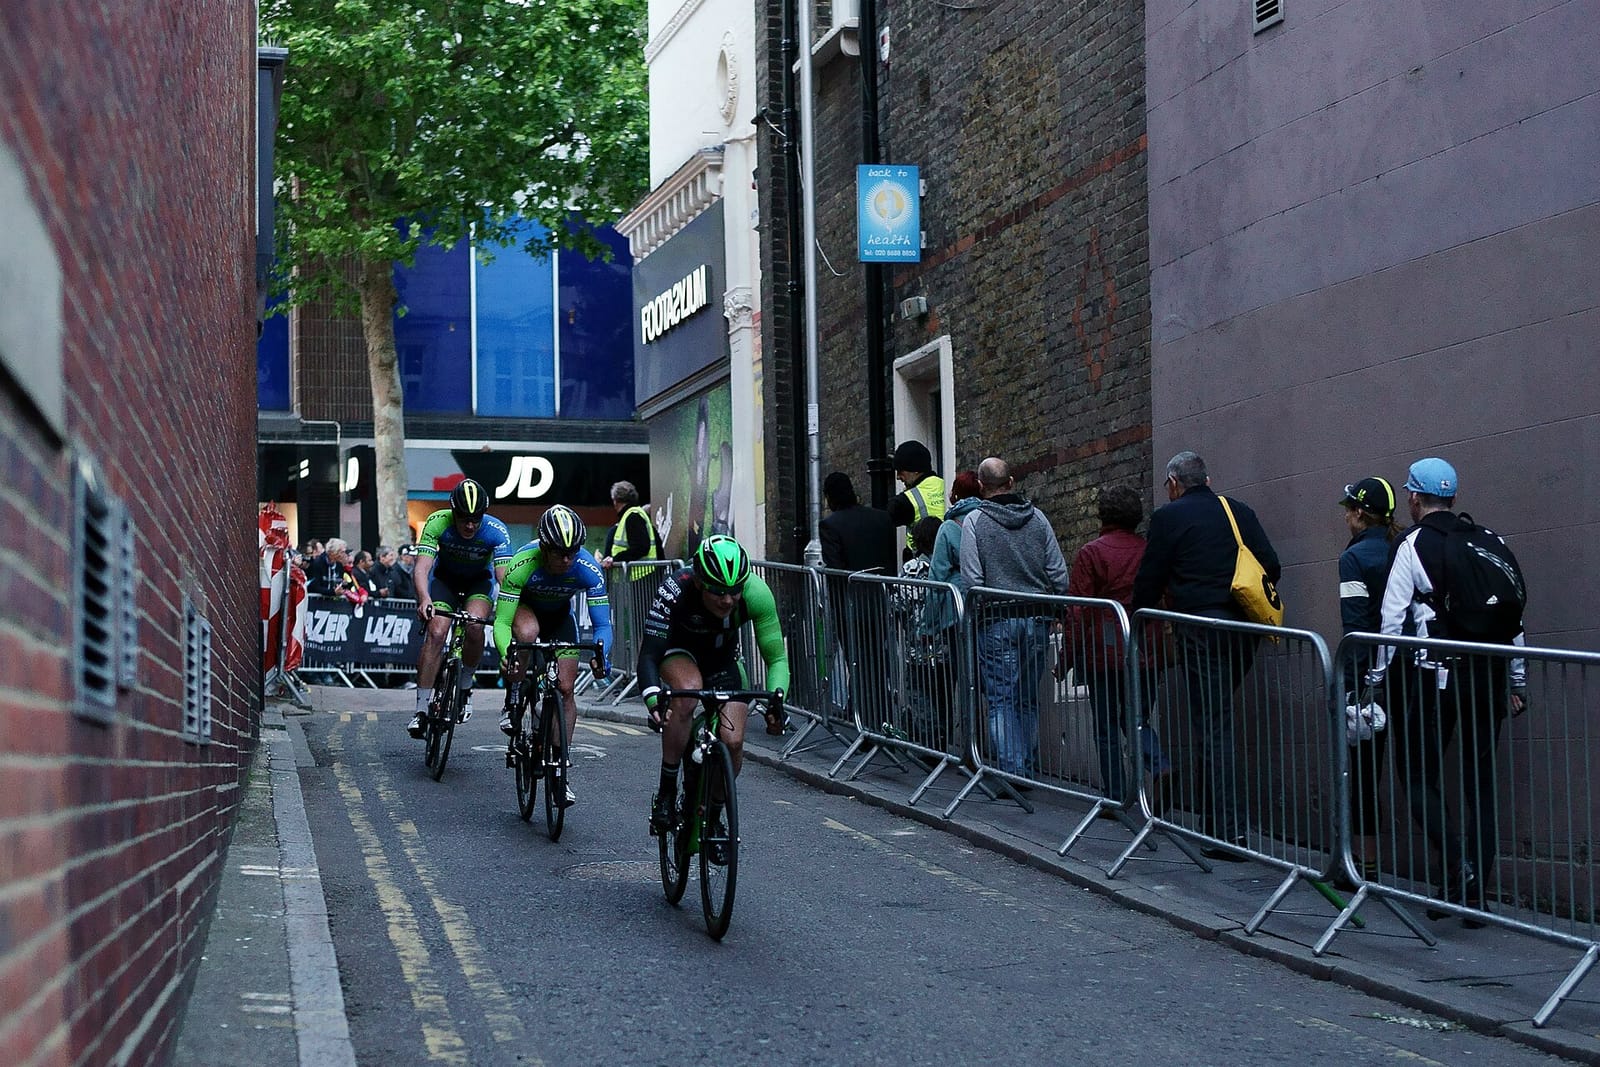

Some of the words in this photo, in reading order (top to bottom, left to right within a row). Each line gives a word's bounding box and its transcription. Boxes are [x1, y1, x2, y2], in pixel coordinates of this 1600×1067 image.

[868, 168, 892, 177] back
[897, 169, 908, 177] to
[867, 234, 911, 245] health
[641, 264, 707, 345] FOOTASYLUM
[495, 456, 554, 499] JD
[576, 557, 605, 586] KUOTA
[304, 609, 350, 644] AZER
[363, 614, 412, 646] LAZER
